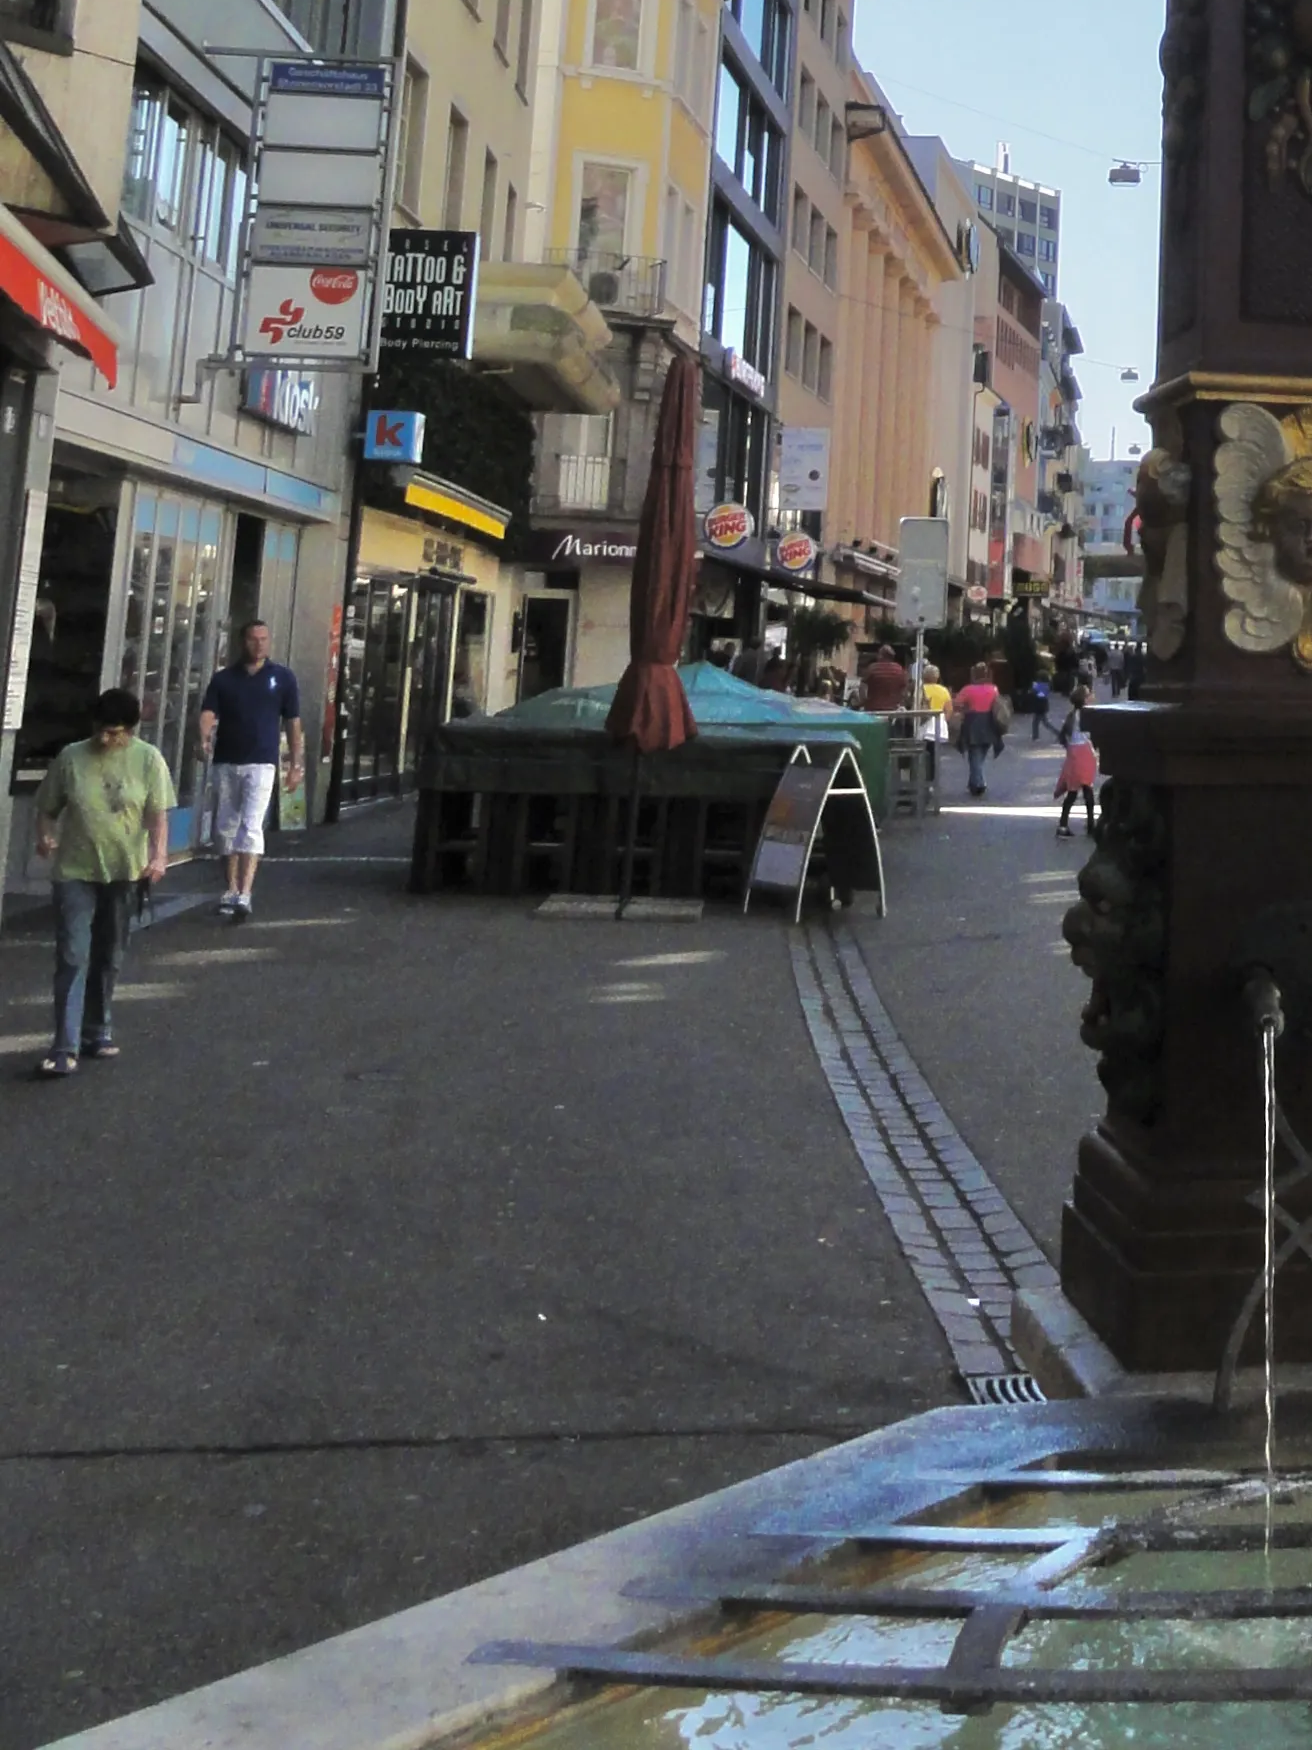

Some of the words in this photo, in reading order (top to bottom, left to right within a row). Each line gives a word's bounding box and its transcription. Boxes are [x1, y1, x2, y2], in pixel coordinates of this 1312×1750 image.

[452, 254, 468, 285] &
[379, 337, 408, 351] Body
[411, 337, 460, 352] Piercing
[708, 521, 747, 540] KING
[781, 546, 812, 563] KING
